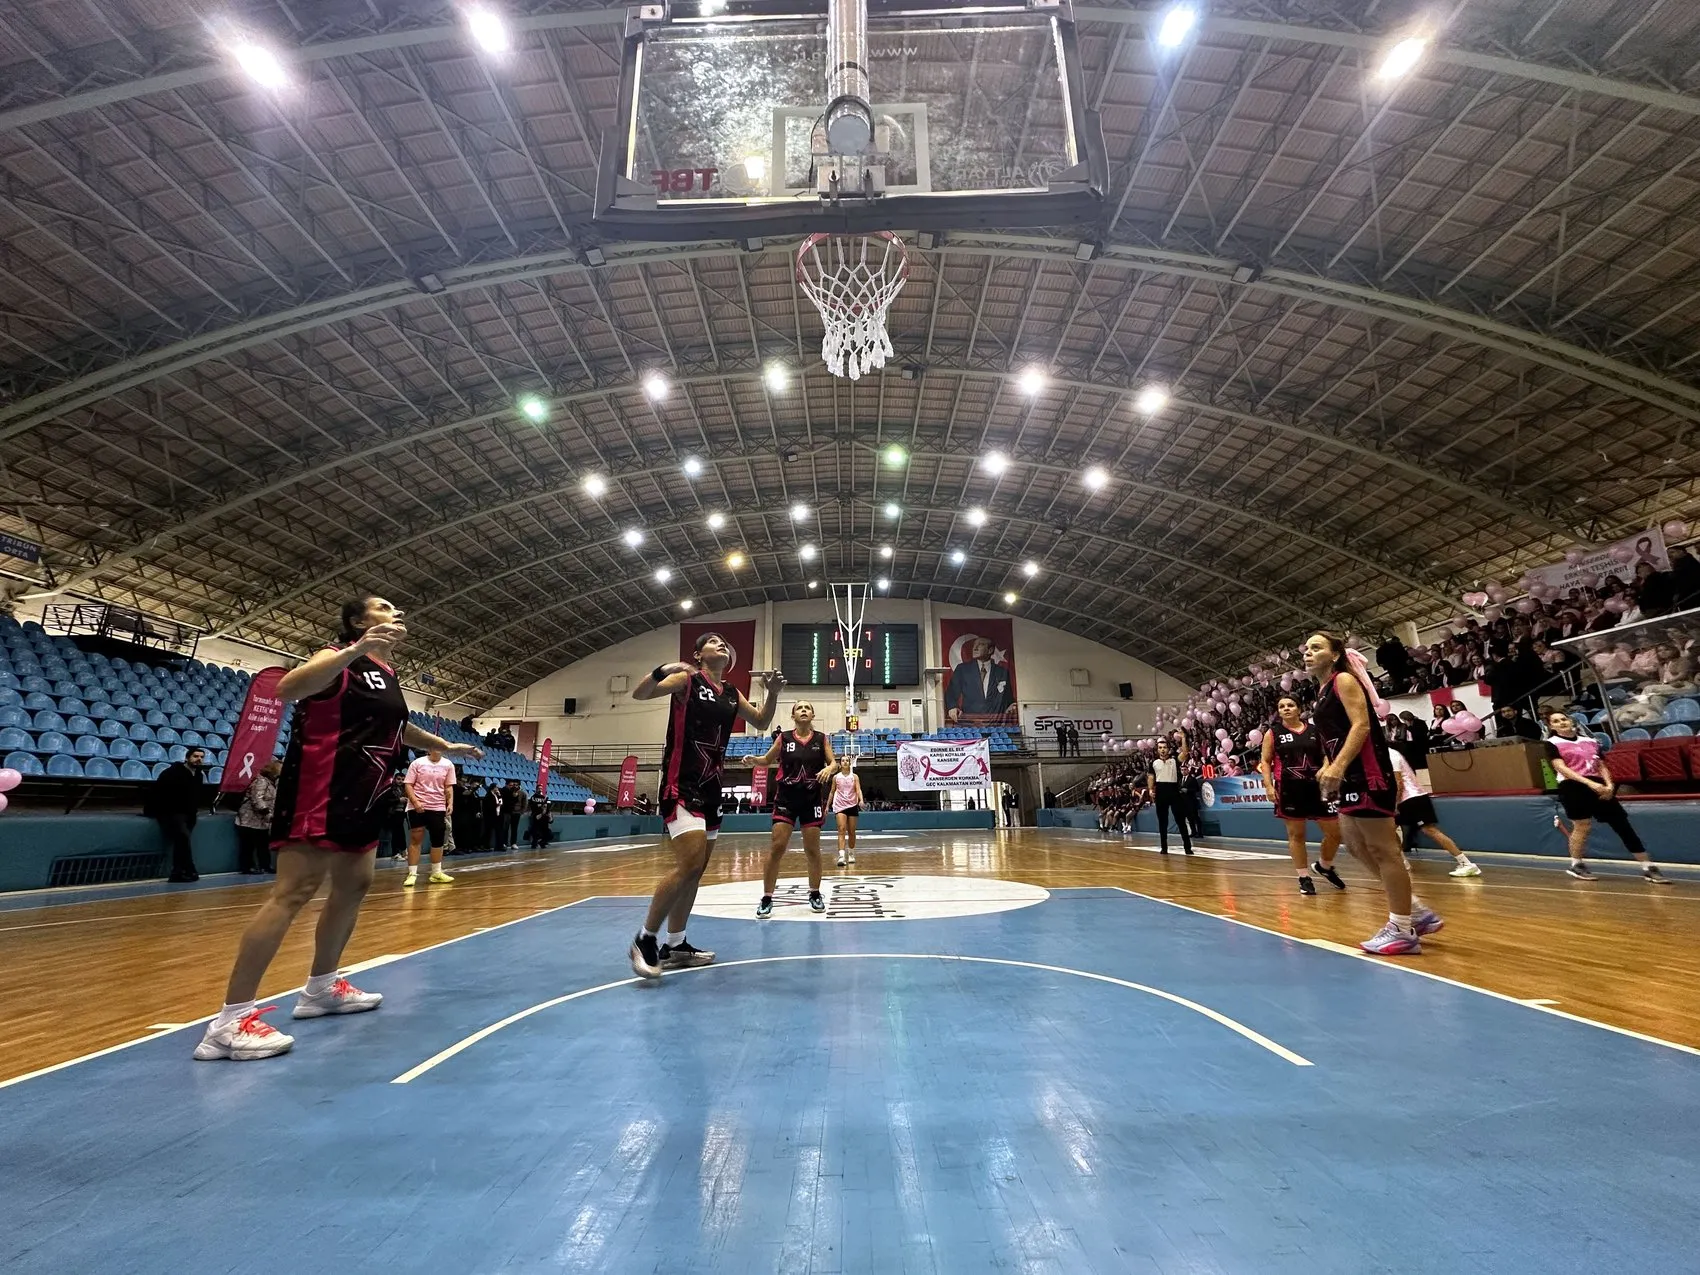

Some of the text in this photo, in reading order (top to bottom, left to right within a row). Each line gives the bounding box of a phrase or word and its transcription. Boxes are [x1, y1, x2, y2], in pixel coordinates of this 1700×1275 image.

[829, 658, 836, 668] 0
[865, 658, 872, 668] 0
[363, 671, 386, 690] 15
[699, 685, 716, 702] 22
[1279, 733, 1294, 743] 39
[786, 742, 796, 752] 19
[814, 806, 822, 818] 19
